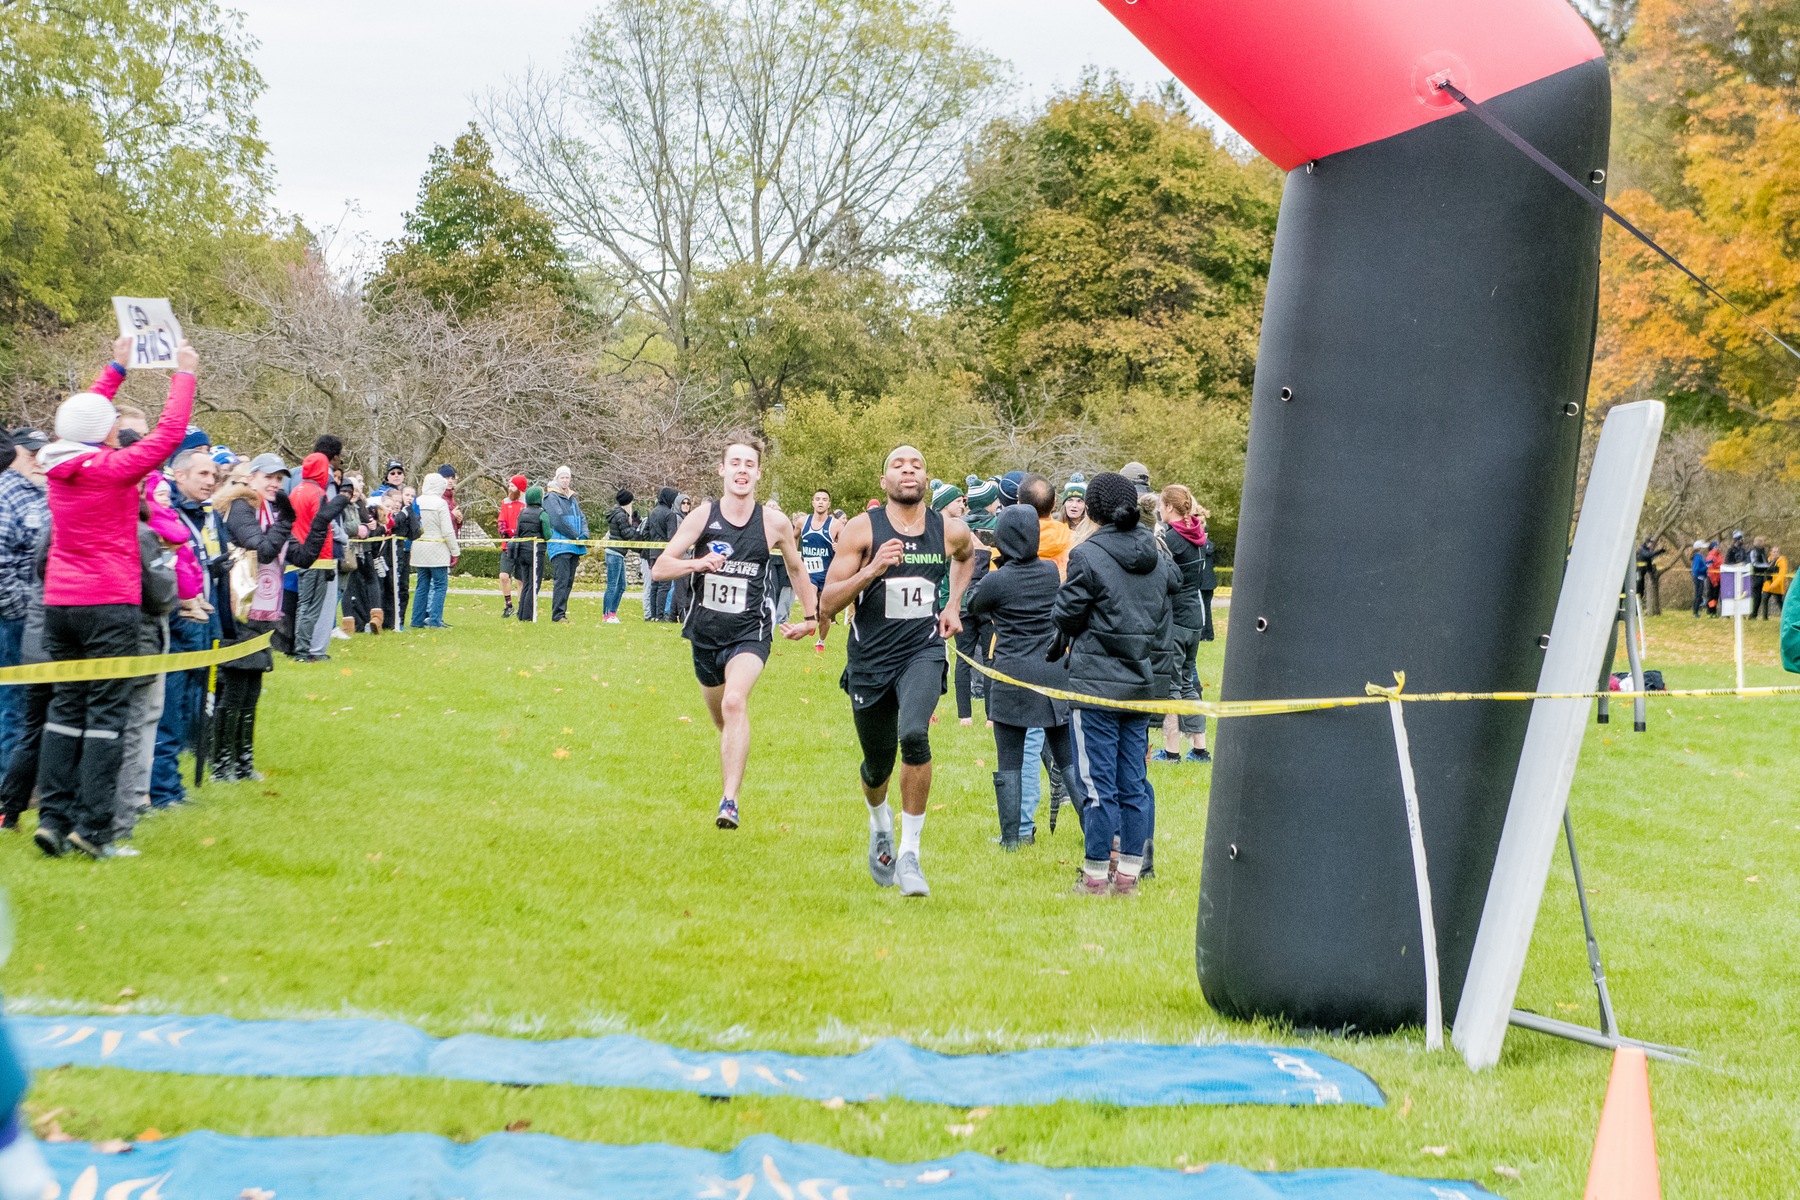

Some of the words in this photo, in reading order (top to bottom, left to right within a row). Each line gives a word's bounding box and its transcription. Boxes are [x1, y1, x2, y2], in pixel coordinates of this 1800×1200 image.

[802, 546, 829, 557] NIAGARA
[900, 553, 944, 564] TENNIAL
[807, 560, 820, 570] 111
[710, 583, 738, 605] 131
[900, 587, 923, 607] 14
